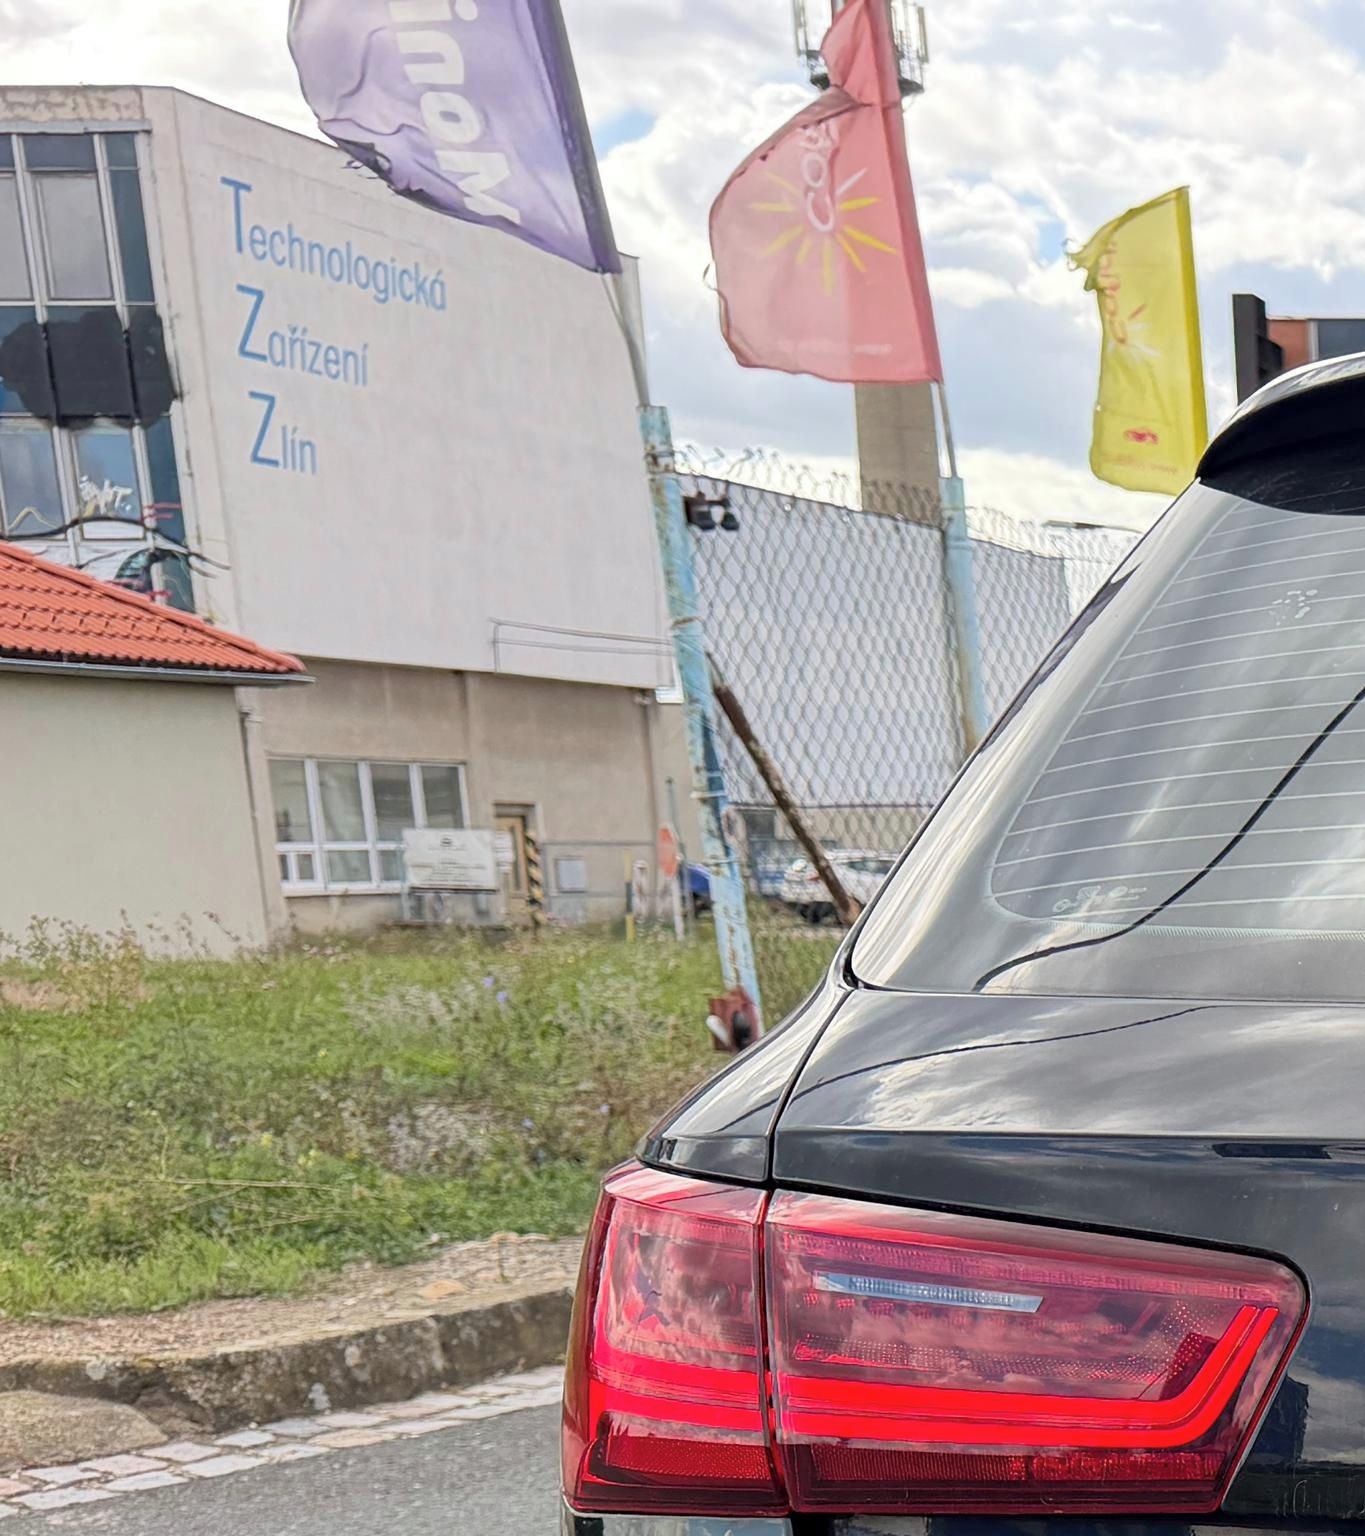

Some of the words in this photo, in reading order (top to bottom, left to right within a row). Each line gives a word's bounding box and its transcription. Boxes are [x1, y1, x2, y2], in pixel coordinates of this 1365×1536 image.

[219, 175, 448, 311] Technologická
[235, 283, 370, 387] Zařízení
[247, 390, 318, 475] Zlín
